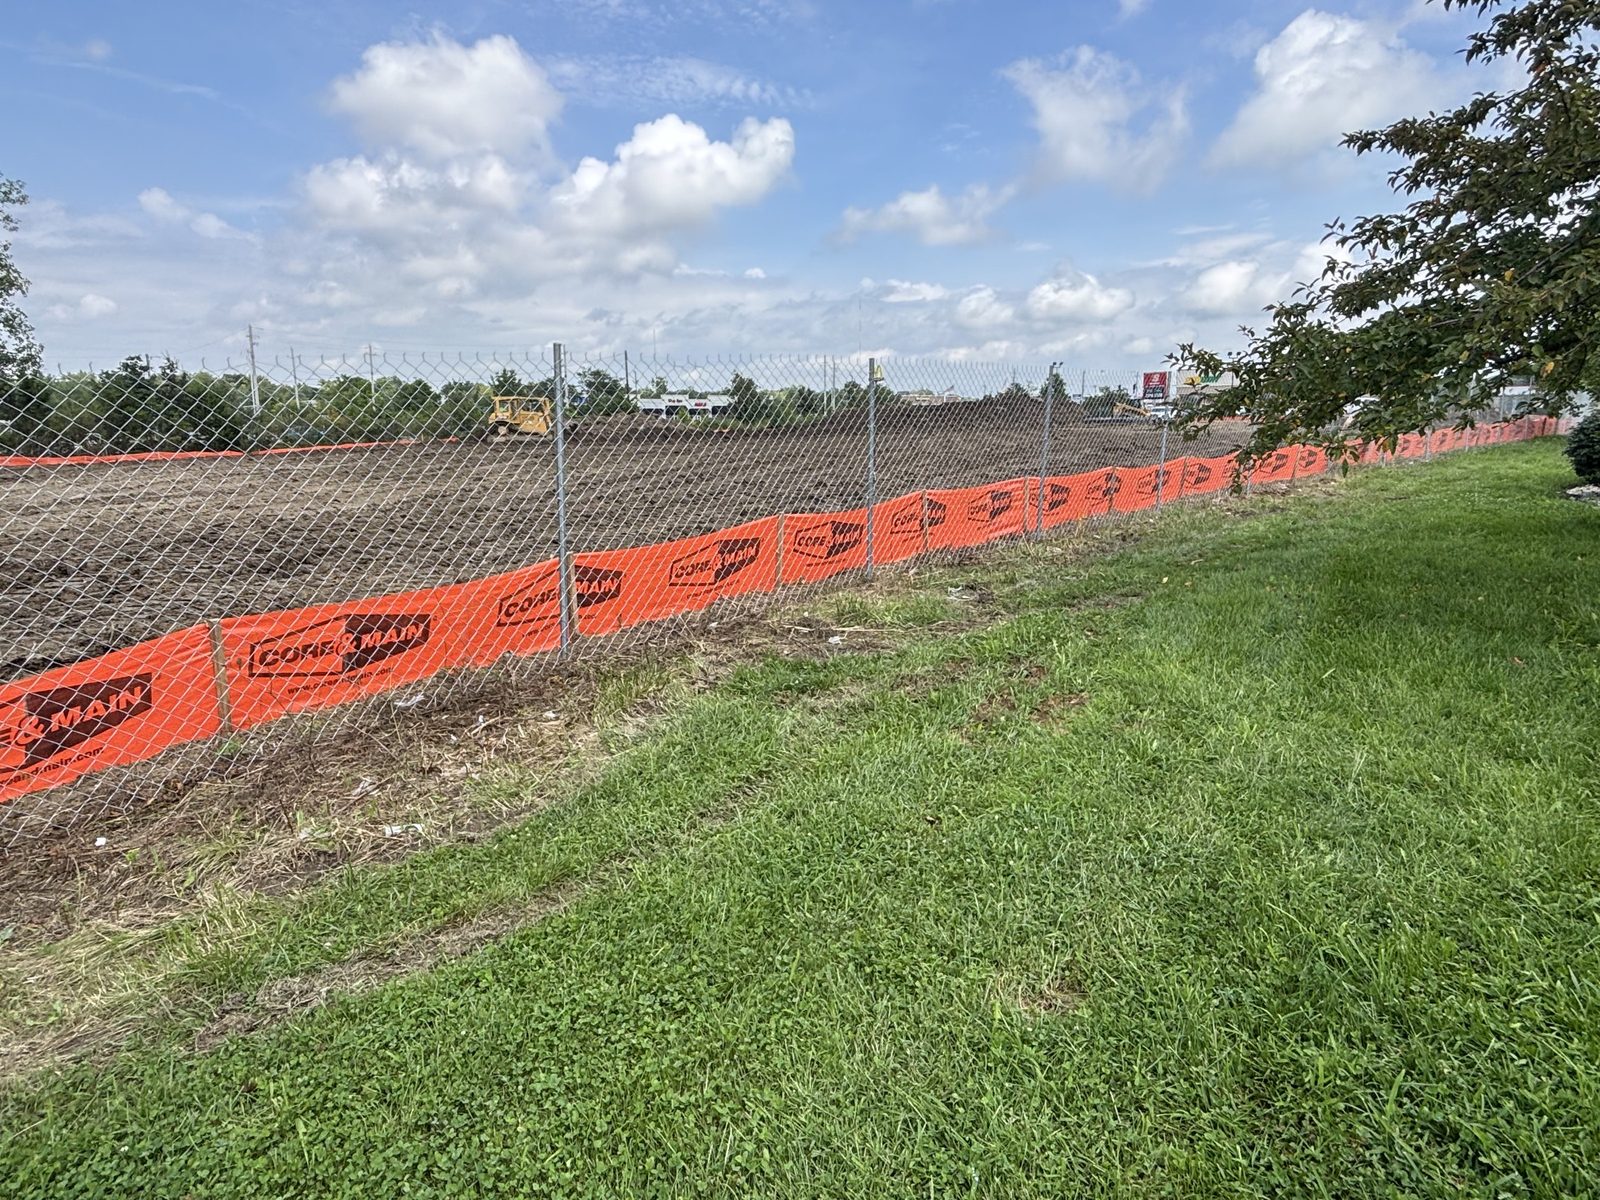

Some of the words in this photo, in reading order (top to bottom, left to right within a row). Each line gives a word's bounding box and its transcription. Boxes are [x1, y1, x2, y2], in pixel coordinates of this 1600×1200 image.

[797, 536, 827, 547] CORE
[674, 560, 712, 579] CORE
[503, 587, 558, 618] CORE
[576, 579, 618, 594] MAIN
[258, 640, 336, 667] CORE
[361, 624, 423, 648] MAIN
[51, 686, 142, 732] MAIN
